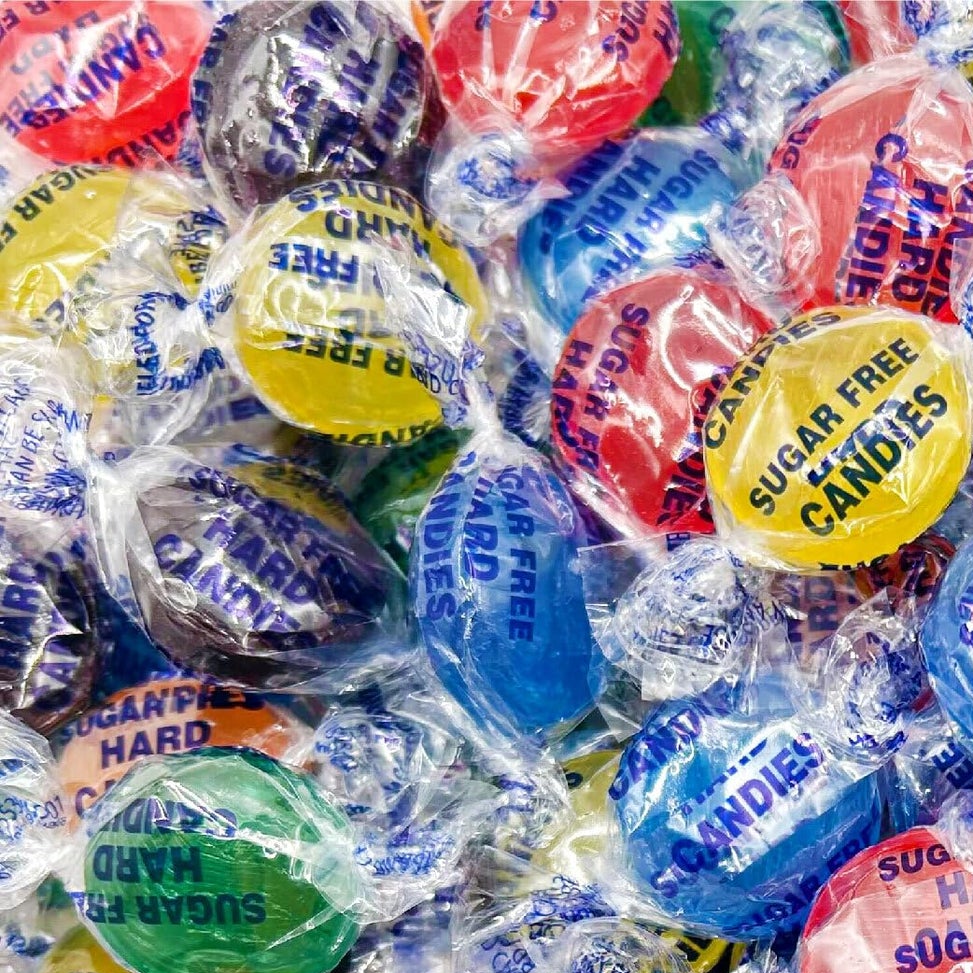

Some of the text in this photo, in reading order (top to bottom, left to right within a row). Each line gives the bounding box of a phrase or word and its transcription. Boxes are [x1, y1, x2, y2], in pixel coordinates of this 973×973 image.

[845, 133, 907, 306] CANDIE
[704, 311, 841, 450] CANDIES
[748, 337, 920, 517] SUGAR FREE
[799, 381, 949, 537] CANDIES
[204, 518, 318, 604] HARD
[463, 475, 498, 583] HARD
[155, 532, 299, 630] CANDI
[509, 548, 536, 643] FREE
[100, 720, 212, 770] HARD
[93, 845, 199, 883] HARD
[139, 893, 266, 925] SUGAR
[878, 843, 950, 882] SUG
